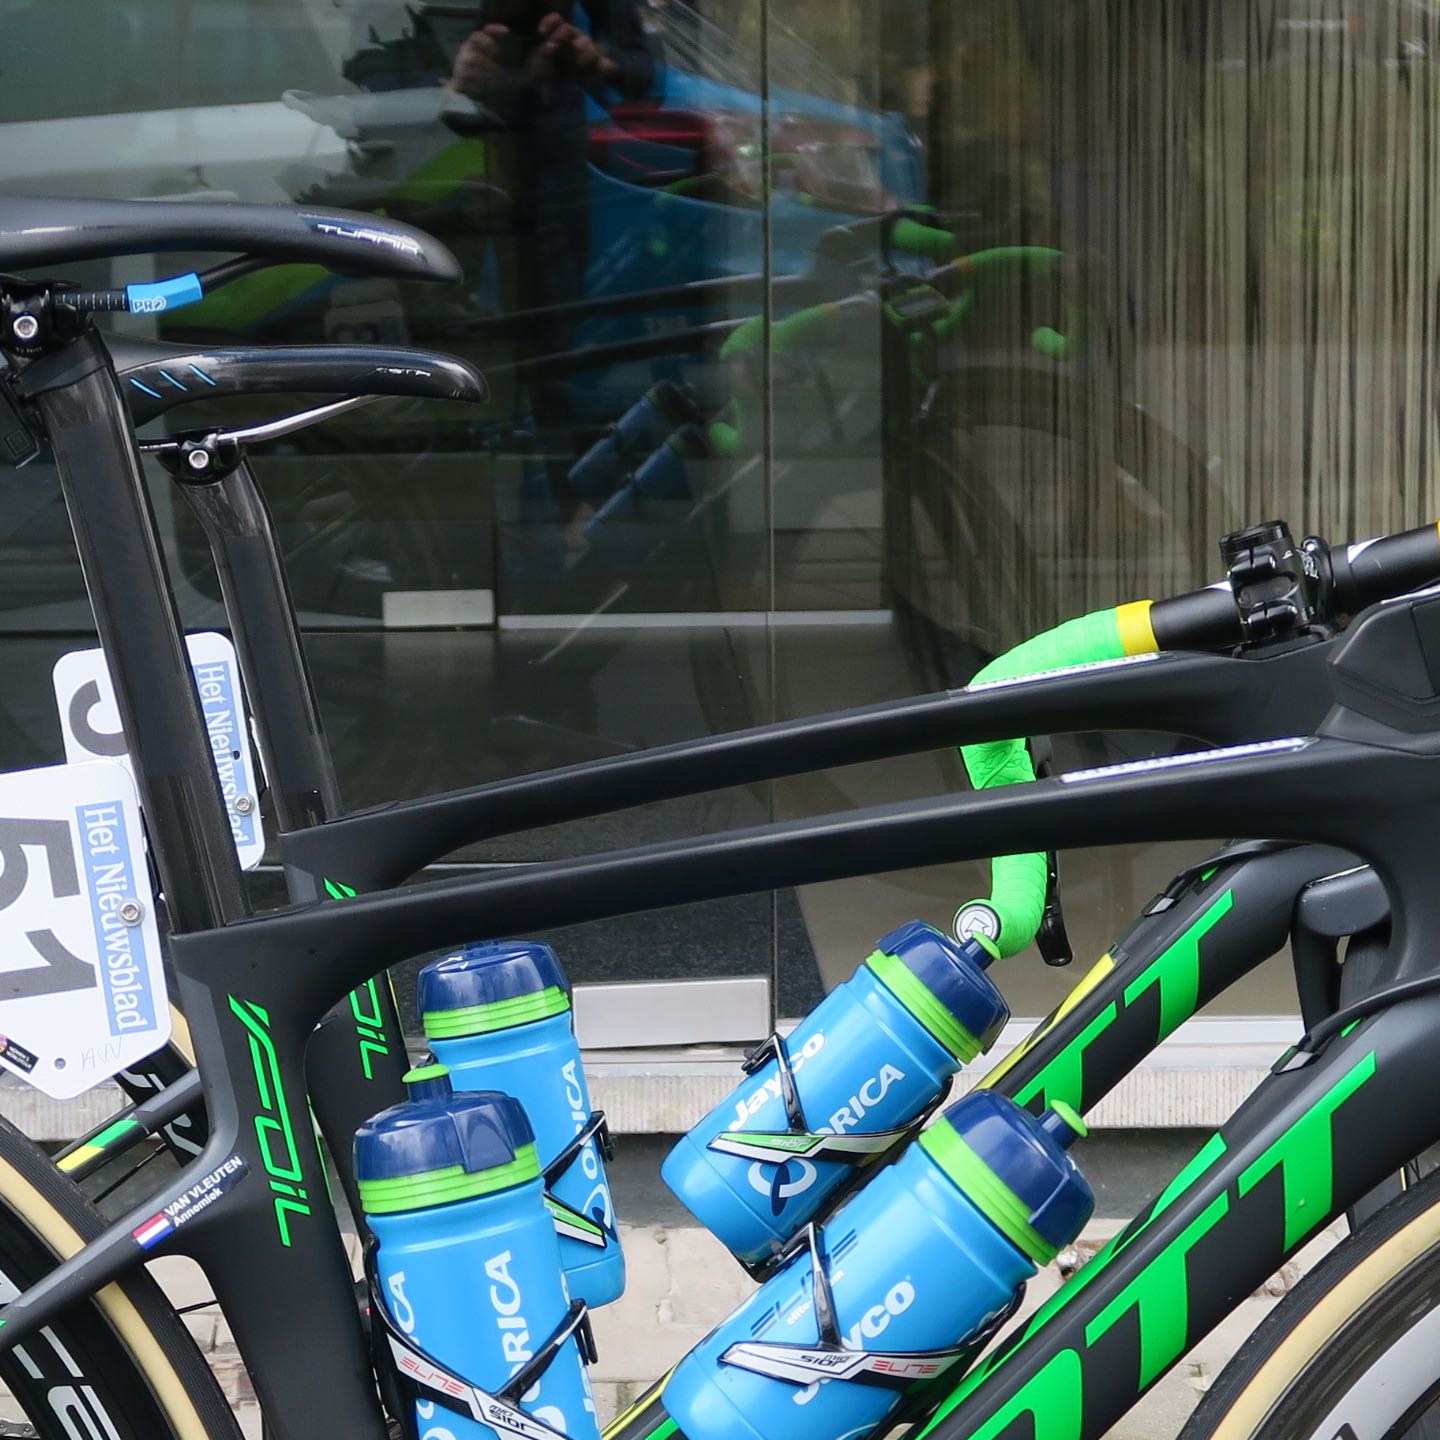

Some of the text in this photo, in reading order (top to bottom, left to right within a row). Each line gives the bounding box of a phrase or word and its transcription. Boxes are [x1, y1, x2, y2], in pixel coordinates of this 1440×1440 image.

[133, 295, 166, 312] PRO
[196, 663, 227, 701] Het
[83, 804, 122, 856] Het
[92, 861, 150, 1036] Nieuwsblad
[164, 1155, 243, 1218] VAN VLEUTEN
[400, 1355, 465, 1396] ELITE
[871, 1359, 941, 1375] ELITE
